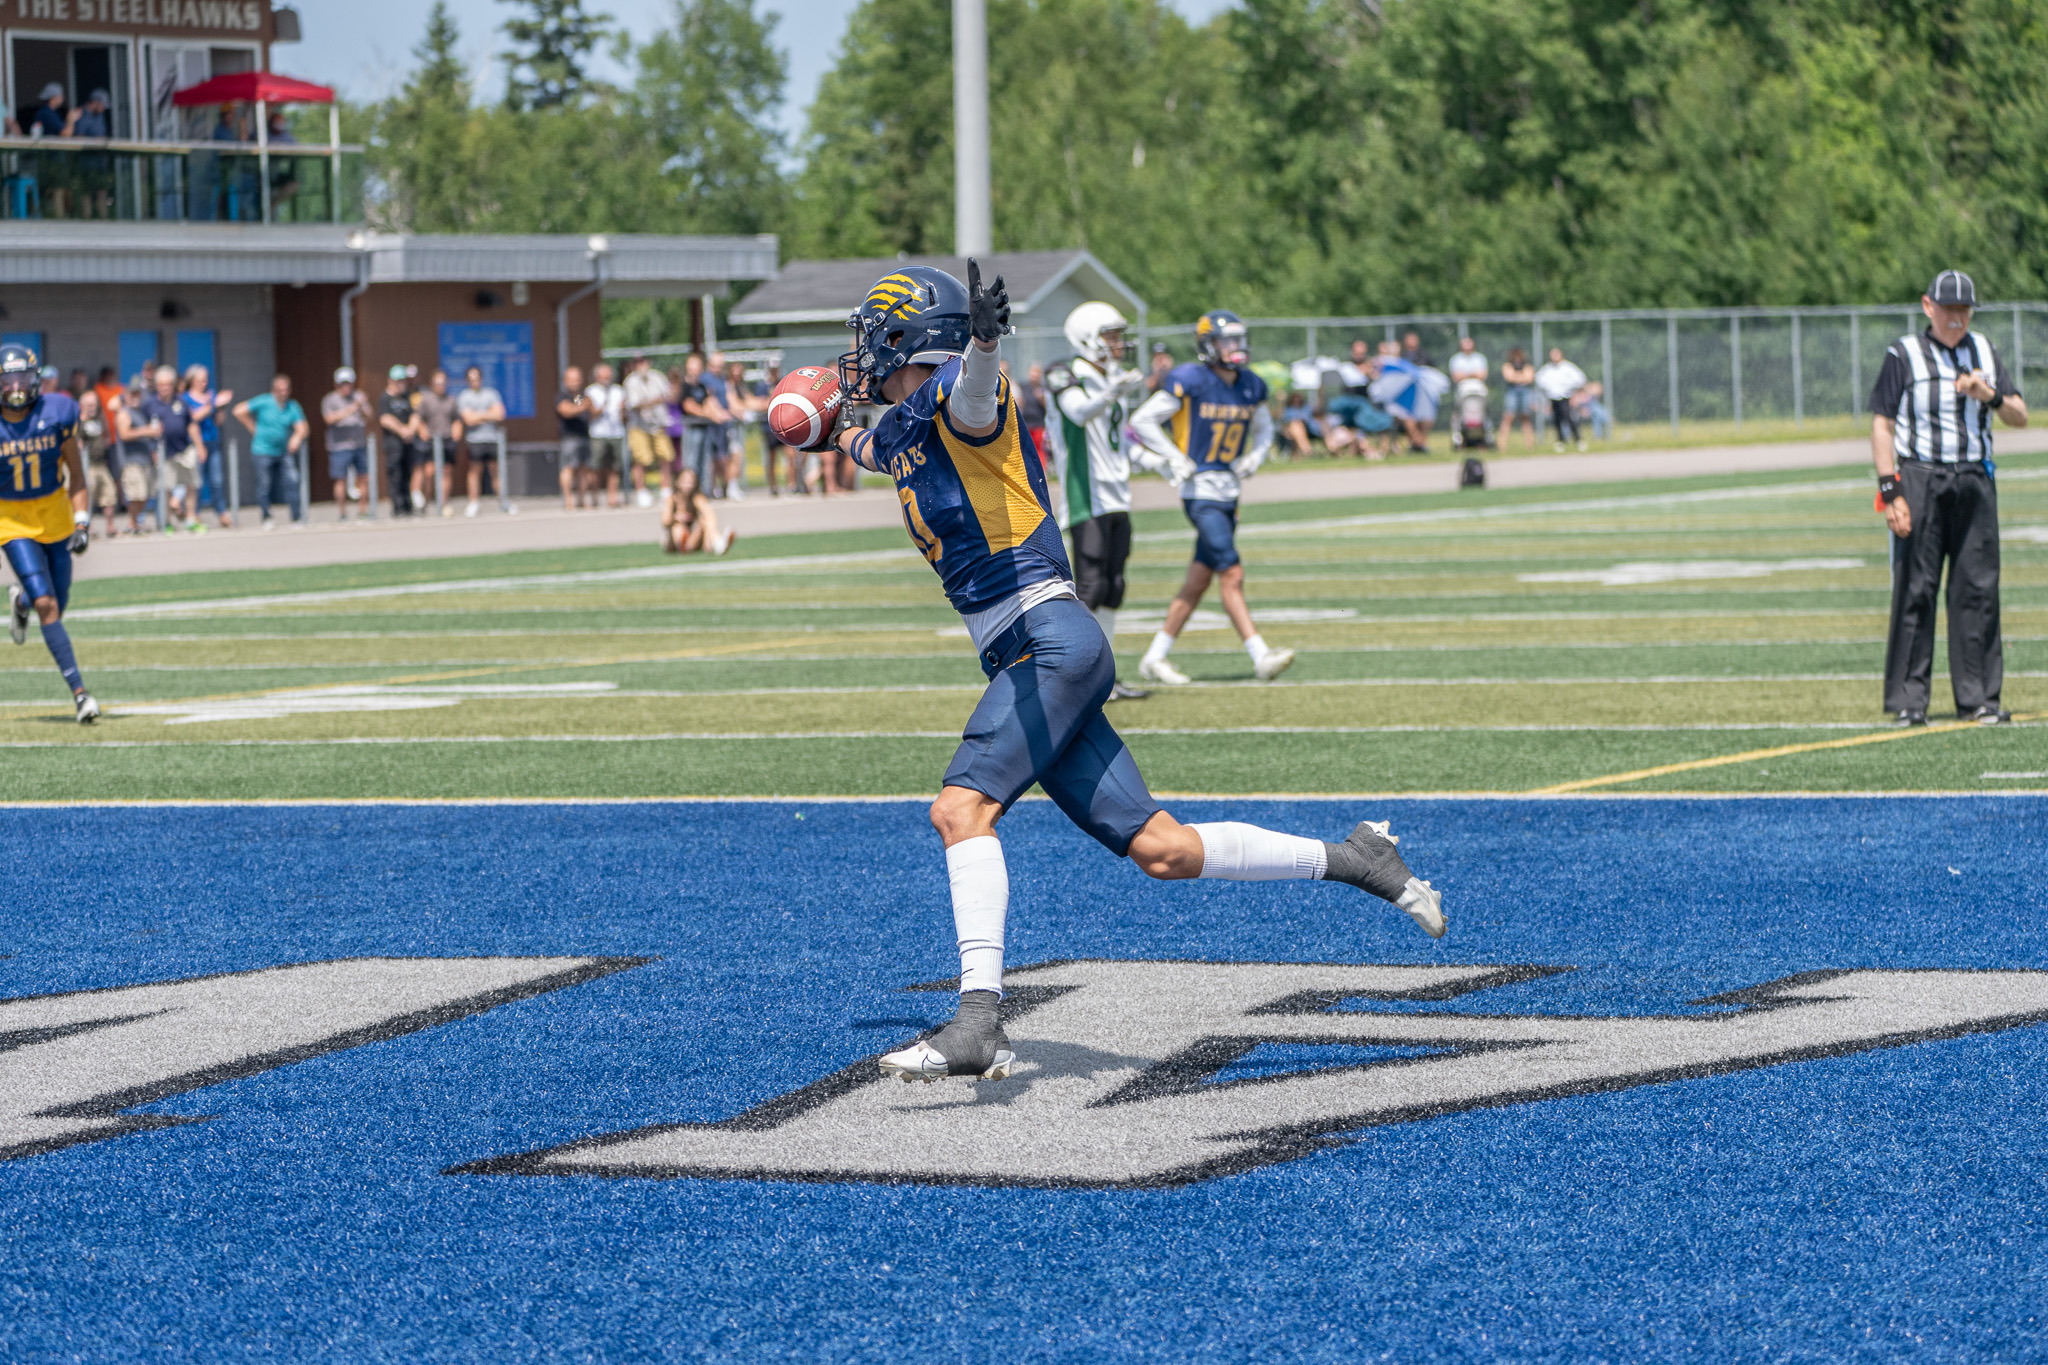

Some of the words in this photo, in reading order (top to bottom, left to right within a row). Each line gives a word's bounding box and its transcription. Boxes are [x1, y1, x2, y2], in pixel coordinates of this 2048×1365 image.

[18, 0, 69, 19] THE
[77, 0, 262, 31] STEELHAWKS
[811, 370, 838, 391] Wilson
[1205, 421, 1246, 463] 19
[8, 452, 41, 491] 11
